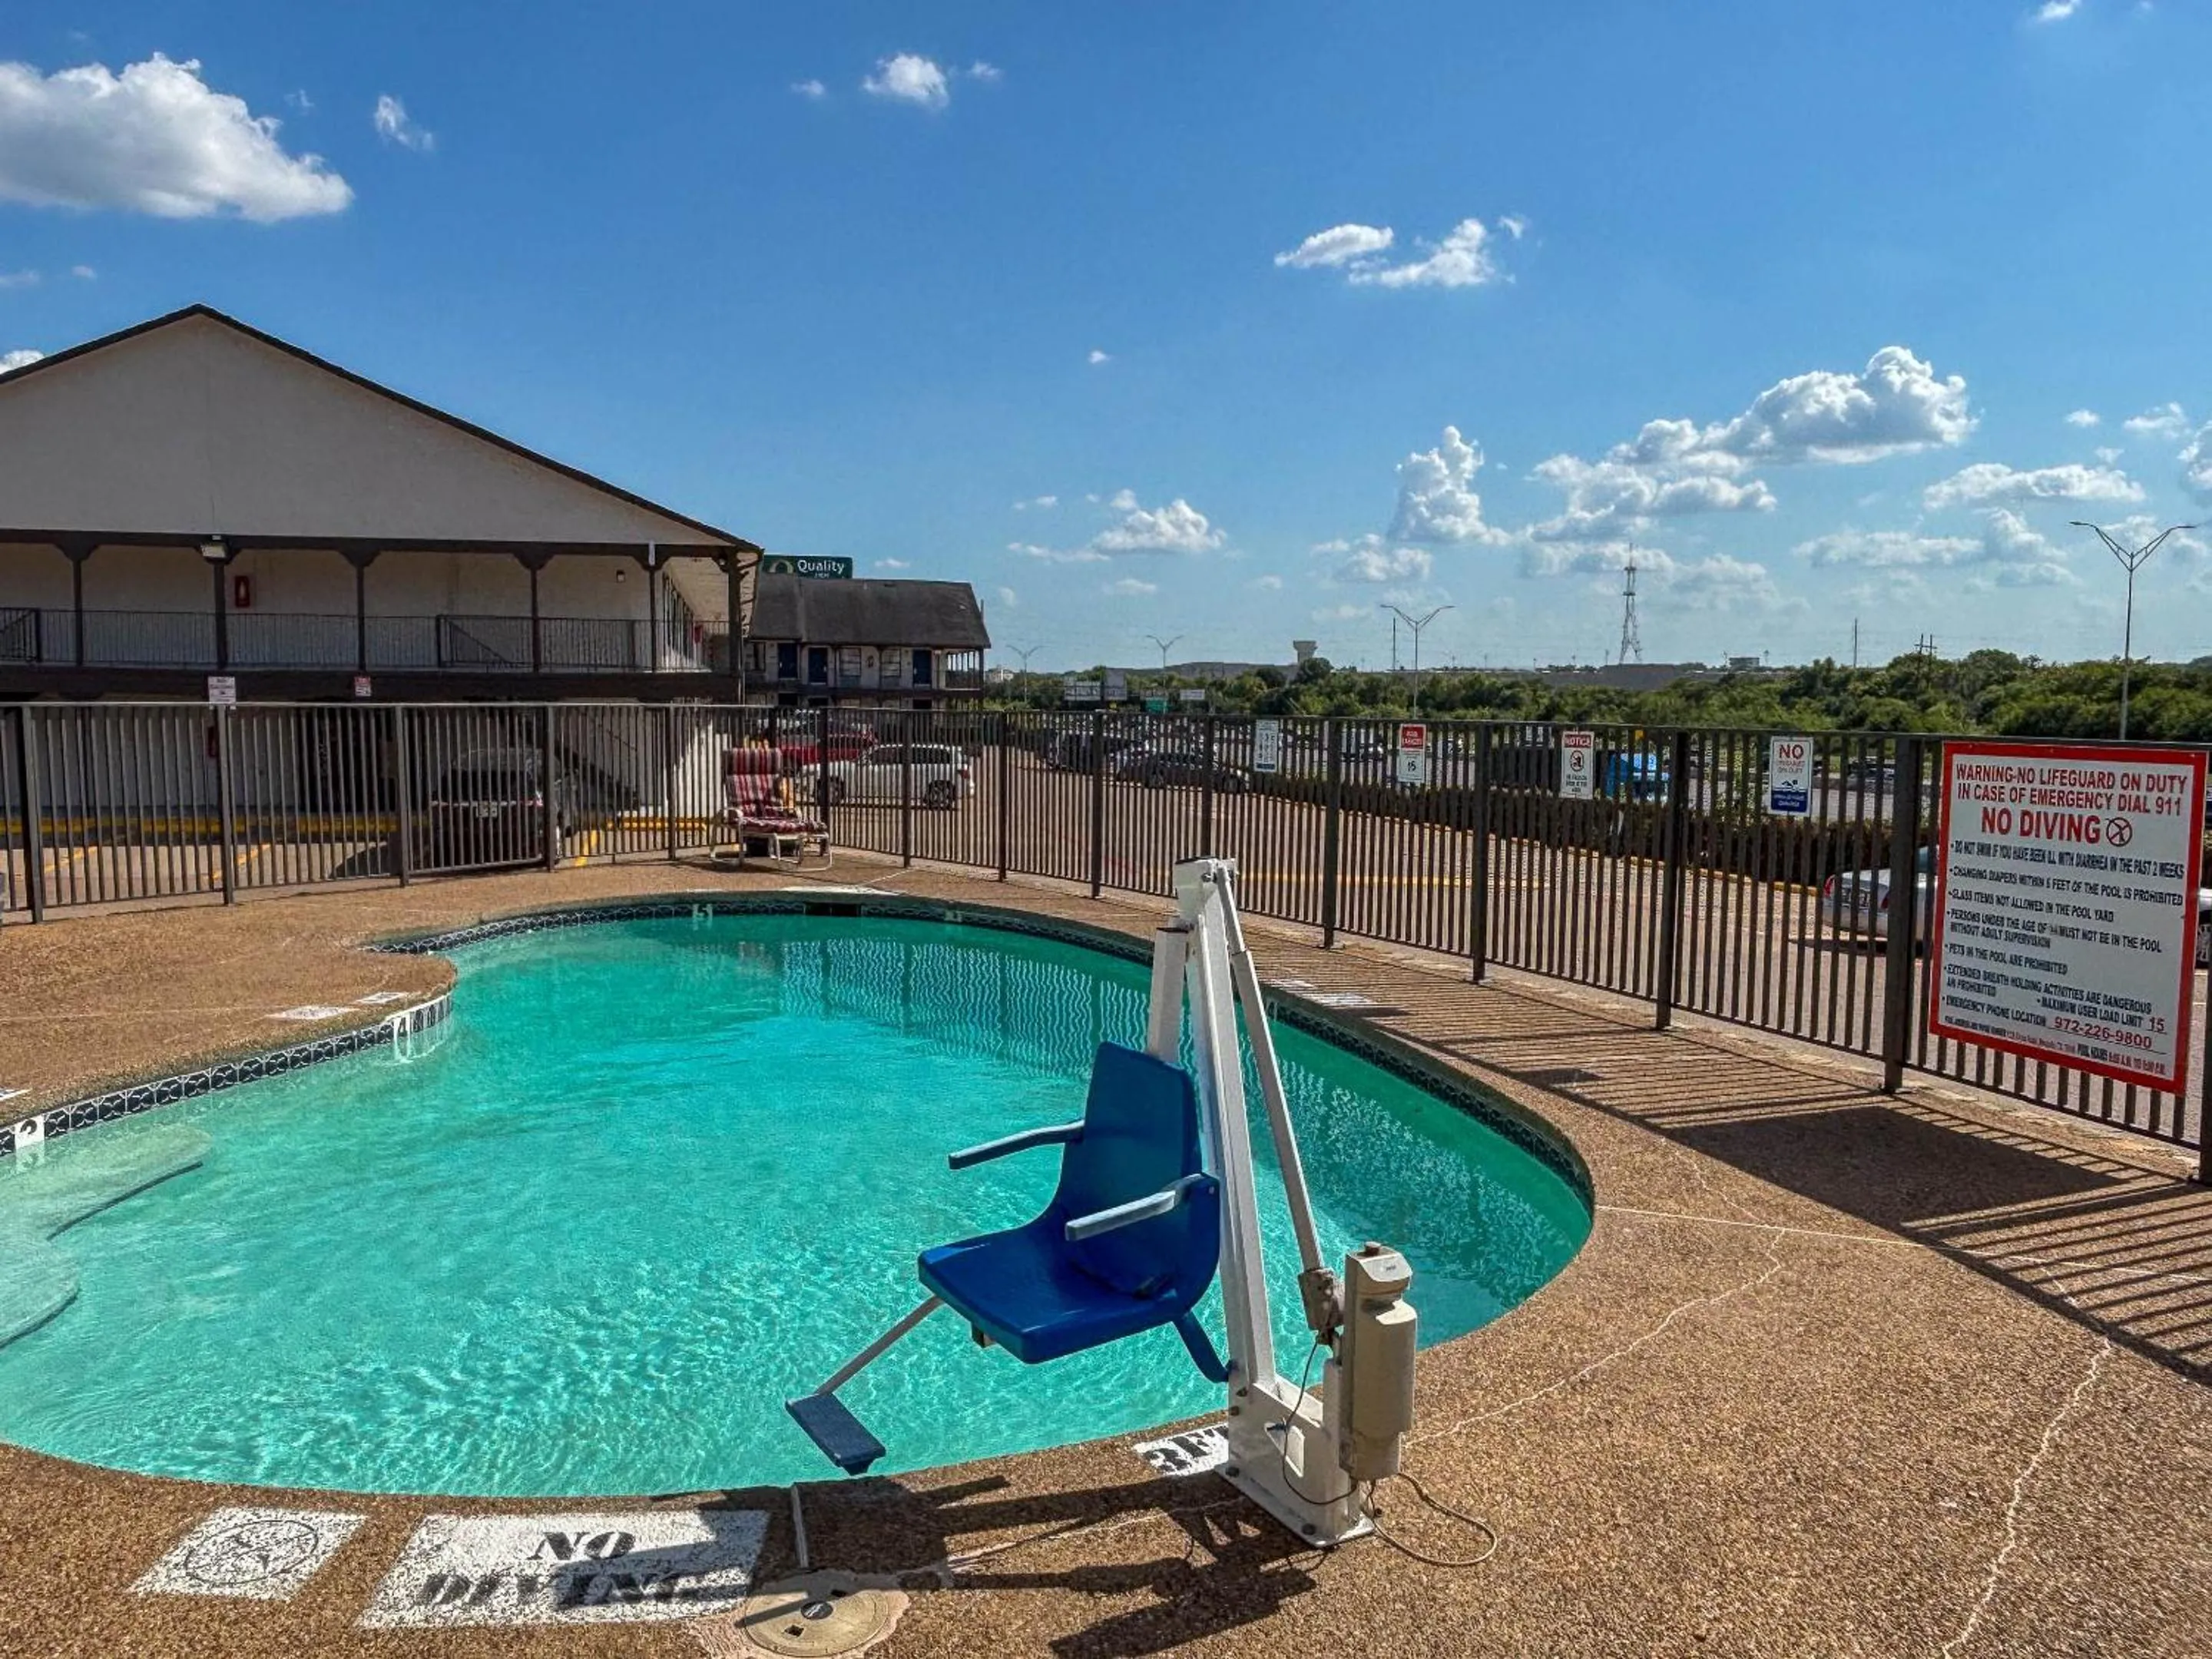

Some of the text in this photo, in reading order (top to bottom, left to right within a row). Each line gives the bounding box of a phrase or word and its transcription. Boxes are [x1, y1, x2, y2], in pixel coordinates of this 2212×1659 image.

[797, 559, 844, 575] Quality
[1780, 744, 1804, 760] NO
[1956, 763, 2187, 794] WARNING-NO LIFEGUARD ON DUTY
[1958, 783, 2181, 816] IN CASE OF EMERGENCY DIAL 911
[1982, 806, 2101, 844] NO DIVING
[1999, 844, 2012, 859] YOU
[2013, 846, 2029, 861] HAVE
[2030, 847, 2046, 863] BEEN
[2110, 856, 2118, 872] IN
[2119, 857, 2133, 873] THE
[2134, 859, 2152, 875] PAST
[2152, 861, 2157, 876] 2
[2159, 863, 2184, 879] WEEKS
[1953, 866, 1987, 879] CHANGING
[1988, 869, 2018, 884] DIAPERS
[2019, 873, 2045, 887] WITHIN
[2052, 878, 2071, 891] FEET
[2072, 881, 2082, 892] OF
[2084, 882, 2100, 896] THE
[2101, 884, 2121, 899] POOL
[2124, 887, 2132, 899] IS
[2134, 889, 2183, 906] PROHIBITED
[1952, 889, 2114, 922] GLASS ITEMS NOT ALLOWED IN THE POOL YARD
[1950, 909, 1980, 922] PERSONS
[1982, 912, 2005, 926] UNDER
[2006, 917, 2020, 929] THE
[2022, 919, 2035, 932] AGE
[2038, 922, 2048, 934] OF
[2059, 926, 2079, 939] MUST
[2081, 929, 2098, 942] NOT
[2099, 932, 2110, 944] BE
[2112, 933, 2120, 947] IN
[2123, 935, 2139, 949] THE
[2140, 938, 2162, 952] POOL
[1950, 922, 2051, 949] WITHOUT ADULT SUPERVISION
[1949, 943, 2068, 975] PETS IN THE POOL ARE PROHIBITED
[1947, 963, 2151, 1014] EXTENDED BREATH HOLDING ACTIVITIES ARE DANGEROUS
[1946, 995, 1985, 1013] EMERGENCY
[1986, 1004, 2010, 1018] PHONE
[2011, 1008, 2046, 1027] LOCATION
[2054, 1016, 2152, 1048] 972-226-9800
[2041, 997, 2165, 1032] MAXIMUM USER LOAD LIMIT 15
[527, 1532, 636, 1561] NO
